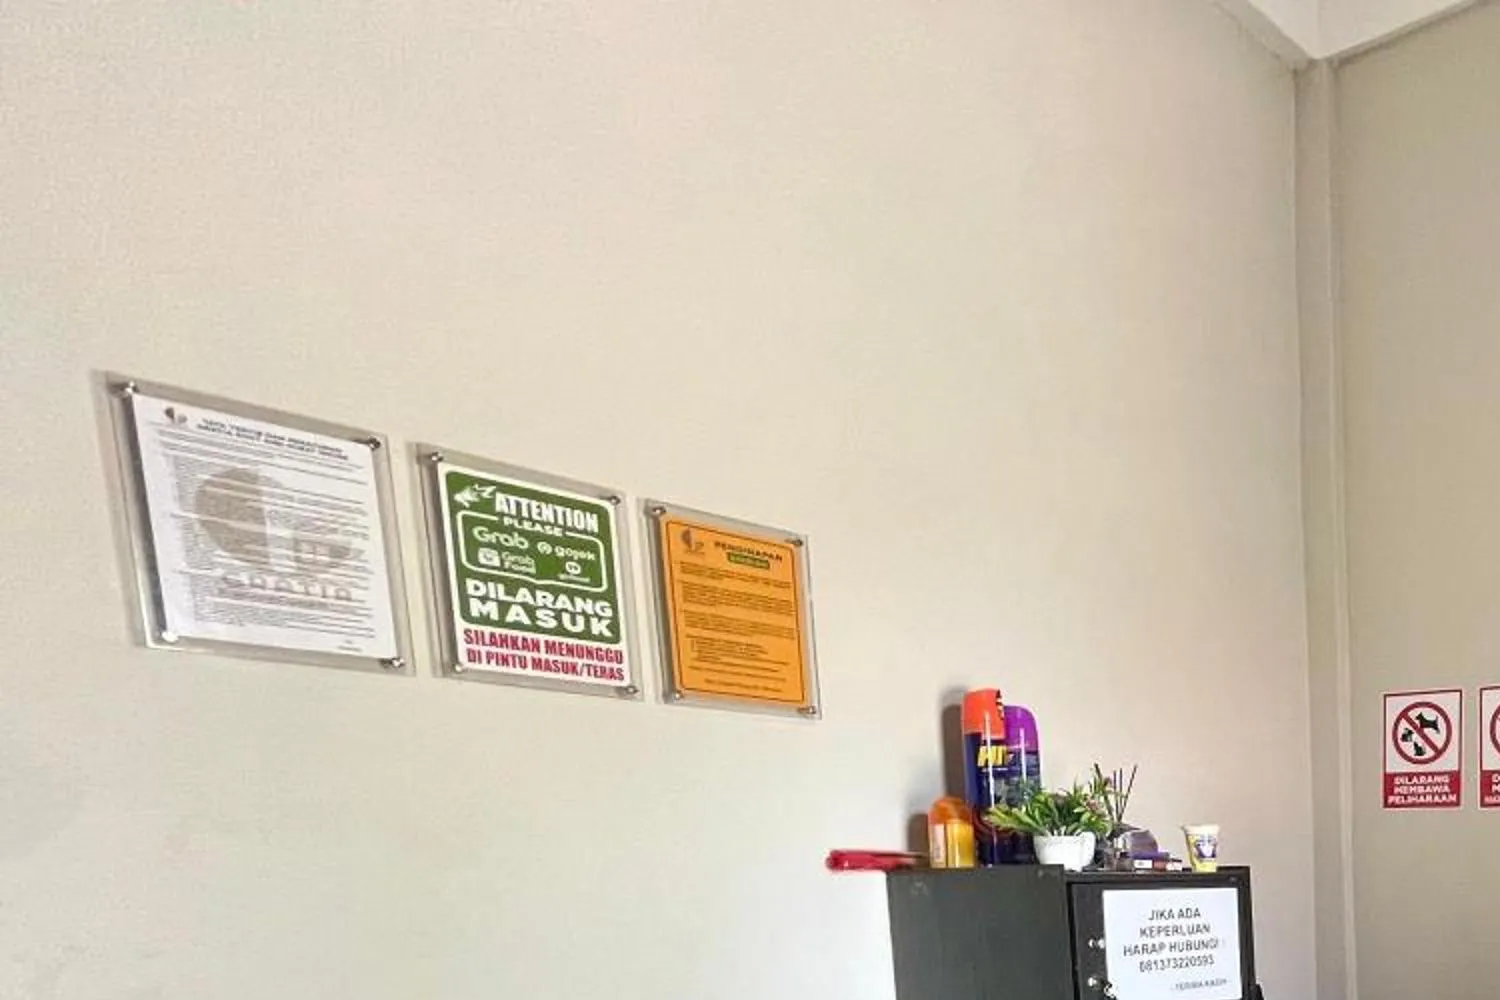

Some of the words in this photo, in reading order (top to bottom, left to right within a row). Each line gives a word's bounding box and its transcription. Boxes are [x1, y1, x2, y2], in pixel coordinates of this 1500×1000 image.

[495, 491, 599, 533] ATTENTION
[503, 516, 563, 537] PLEASE
[472, 526, 529, 550] Grab
[465, 578, 613, 618] DILARANG
[469, 598, 612, 637] MASUK
[463, 628, 541, 653] SILAHKAN
[544, 639, 623, 665] MENUNGGU
[467, 649, 482, 664] DI
[486, 651, 529, 669] PINTU
[1393, 774, 1450, 785] DILARANG
[1393, 784, 1450, 795] MEMBAWA
[1148, 908, 1175, 921] JIKA
[1177, 907, 1201, 919] ADA
[1139, 923, 1211, 939] KEPERLUAN
[1123, 941, 1167, 957] HARAP
